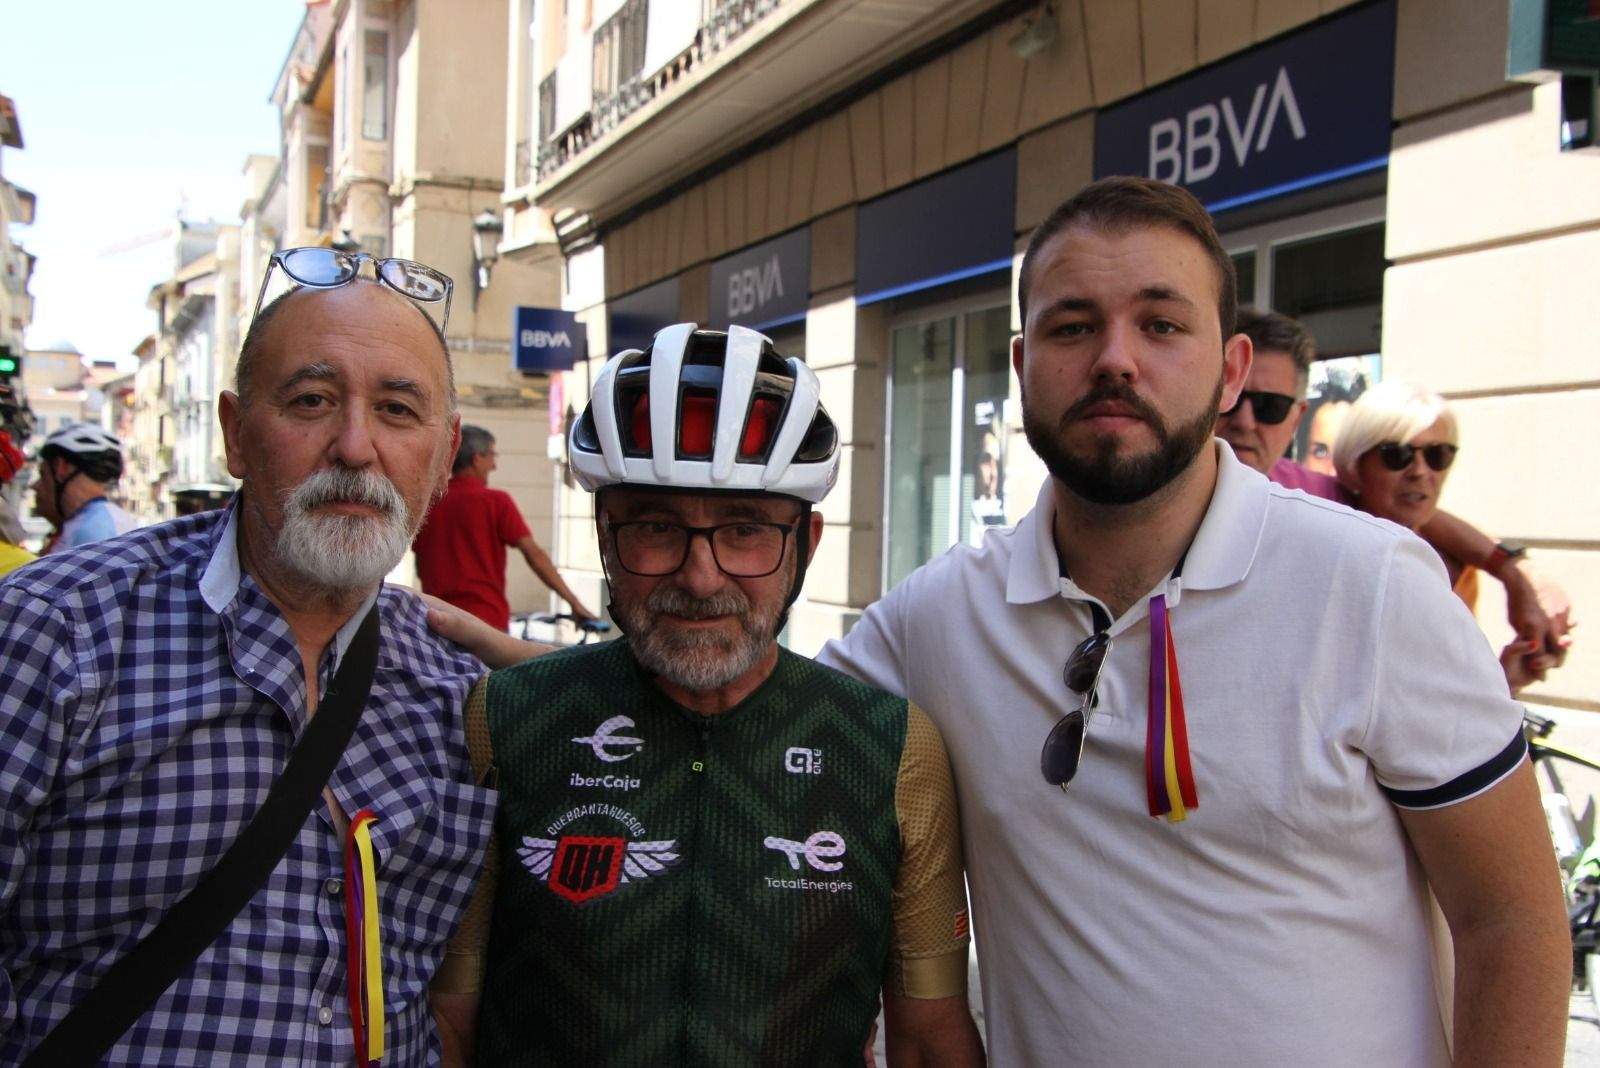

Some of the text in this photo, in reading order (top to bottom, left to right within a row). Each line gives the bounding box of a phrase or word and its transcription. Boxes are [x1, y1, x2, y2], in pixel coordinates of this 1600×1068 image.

[1148, 66, 1306, 186] BBVA
[728, 256, 783, 316] BBVA
[520, 330, 571, 348] BBVA
[570, 773, 641, 791] iberCaja
[547, 803, 646, 837] QUEBRANTAHUESOS
[764, 877, 853, 893] TotalEnergies
